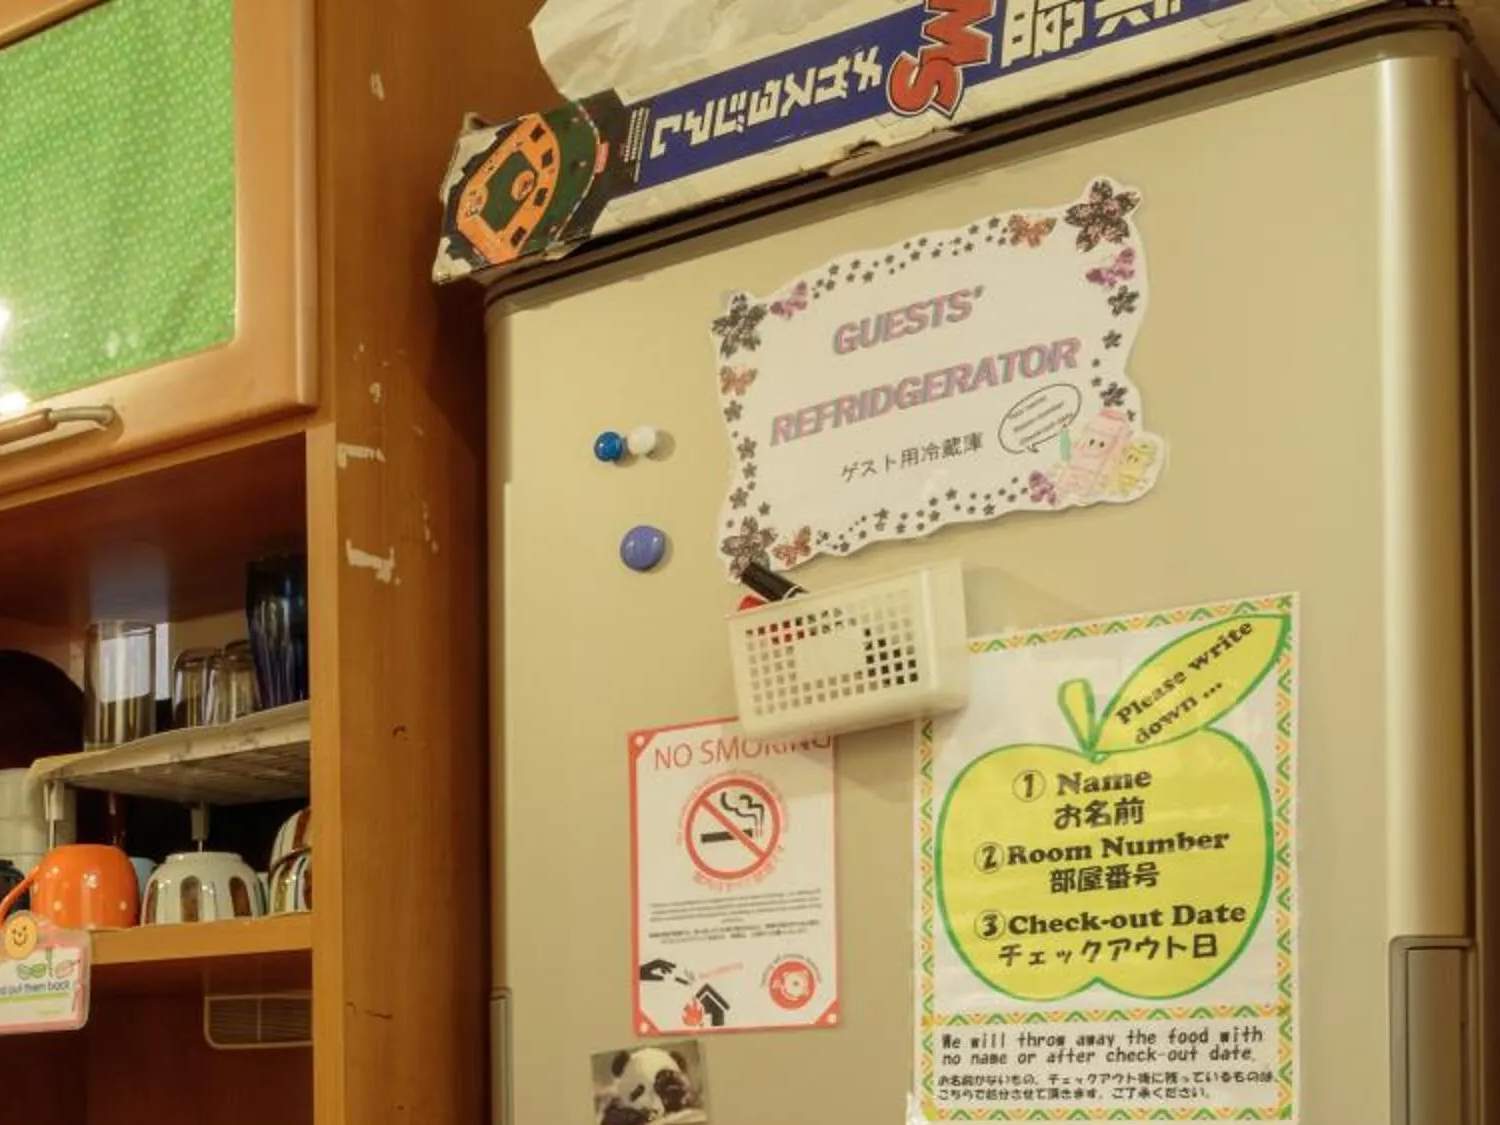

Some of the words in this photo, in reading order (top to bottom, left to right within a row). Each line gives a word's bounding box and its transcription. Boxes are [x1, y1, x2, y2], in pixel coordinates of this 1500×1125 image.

[649, 46, 883, 160] メガスタジアム
[769, 336, 1082, 447] REFRIDGERATOR
[841, 431, 984, 483] ゲスト用冷蔵庫
[1116, 671, 1187, 725] Please
[1188, 622, 1253, 671] write
[1135, 696, 1198, 745] down
[654, 742, 693, 770] NO
[1056, 770, 1152, 796] Name
[1053, 796, 1145, 830] お名前
[1100, 831, 1230, 859] Number
[1049, 861, 1160, 894] 部屋番号
[1171, 903, 1247, 927] Date
[998, 932, 1218, 967] チェックアウト日
[942, 1033, 961, 1049] We
[970, 1033, 1006, 1049] will
[1018, 1031, 1066, 1047] throw
[1075, 1033, 1115, 1047] away
[1127, 1028, 1157, 1045] the
[1168, 1027, 1209, 1044] food
[1220, 1026, 1263, 1043] with
[942, 1052, 961, 1065] no
[970, 1052, 1008, 1065] name
[1017, 1051, 1037, 1065] or
[1046, 1048, 1096, 1063] after
[1105, 1046, 1199, 1063] check-out
